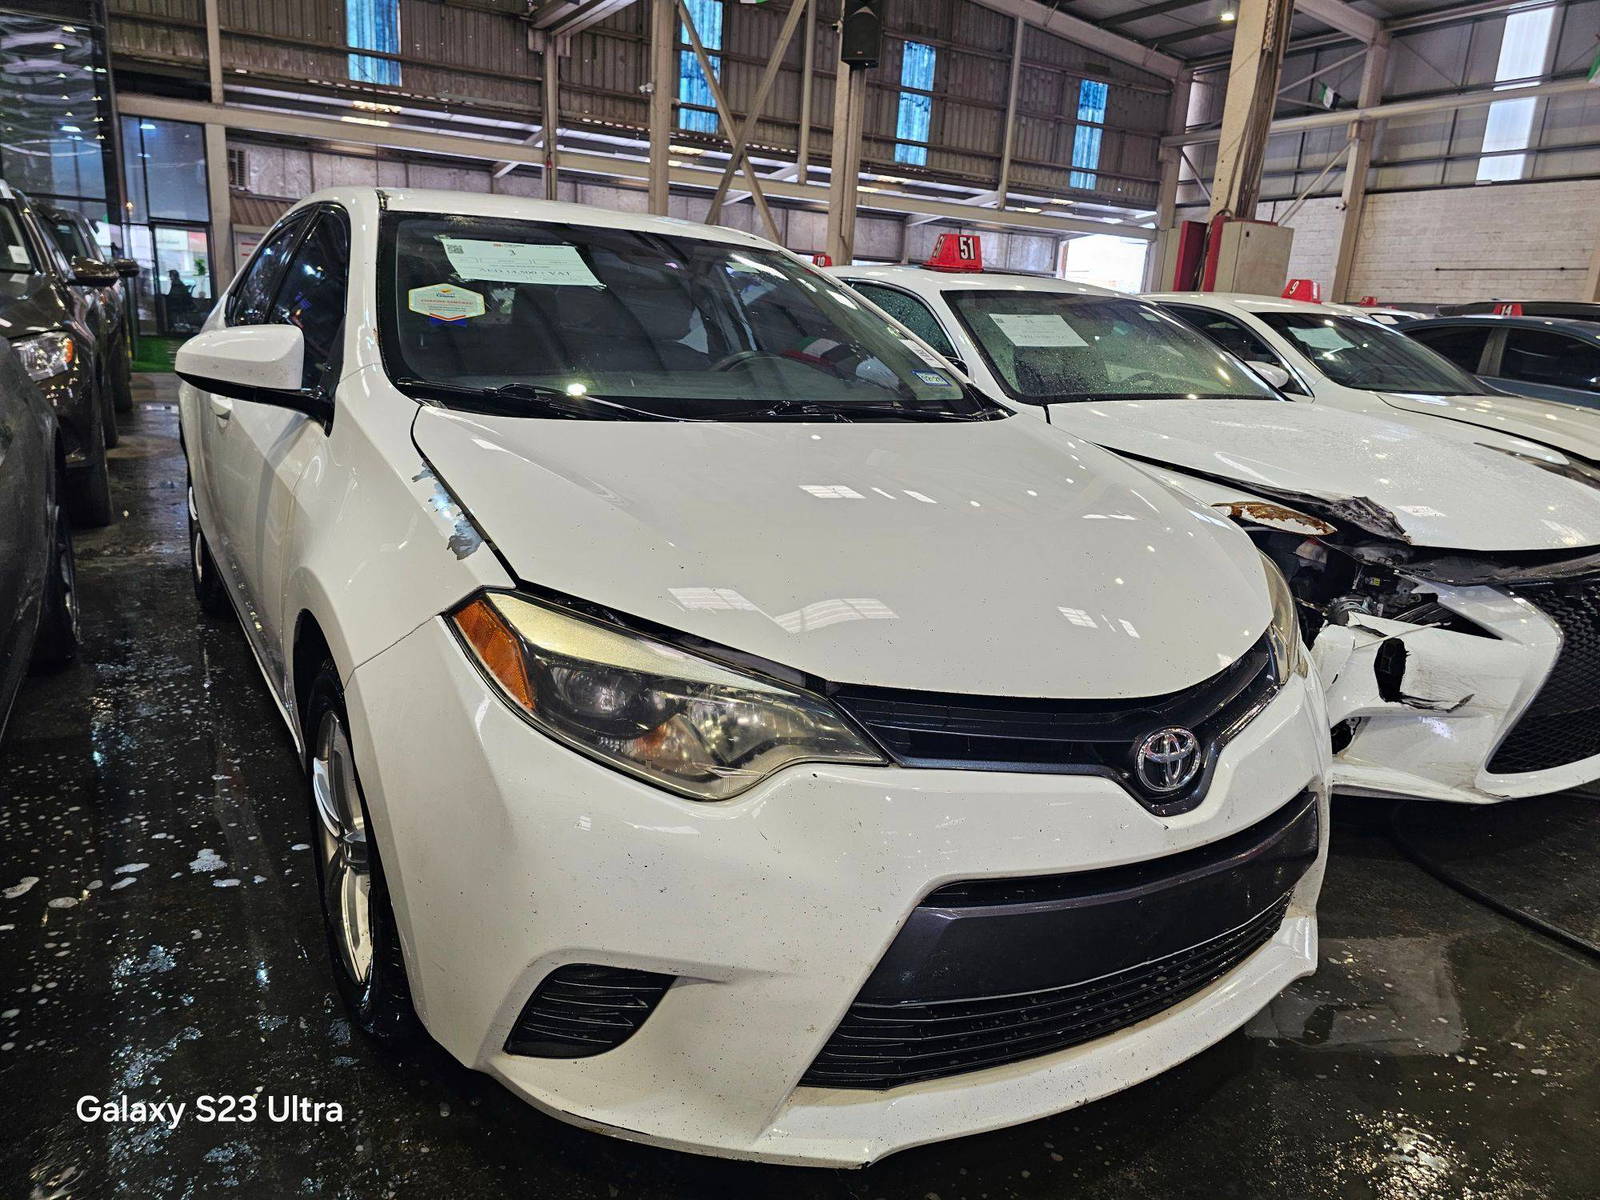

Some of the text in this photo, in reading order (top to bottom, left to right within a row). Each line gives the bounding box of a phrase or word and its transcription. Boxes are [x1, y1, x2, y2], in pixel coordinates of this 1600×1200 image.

[959, 236, 975, 260] 51
[1289, 280, 1300, 295] 9
[1501, 304, 1513, 317] 14
